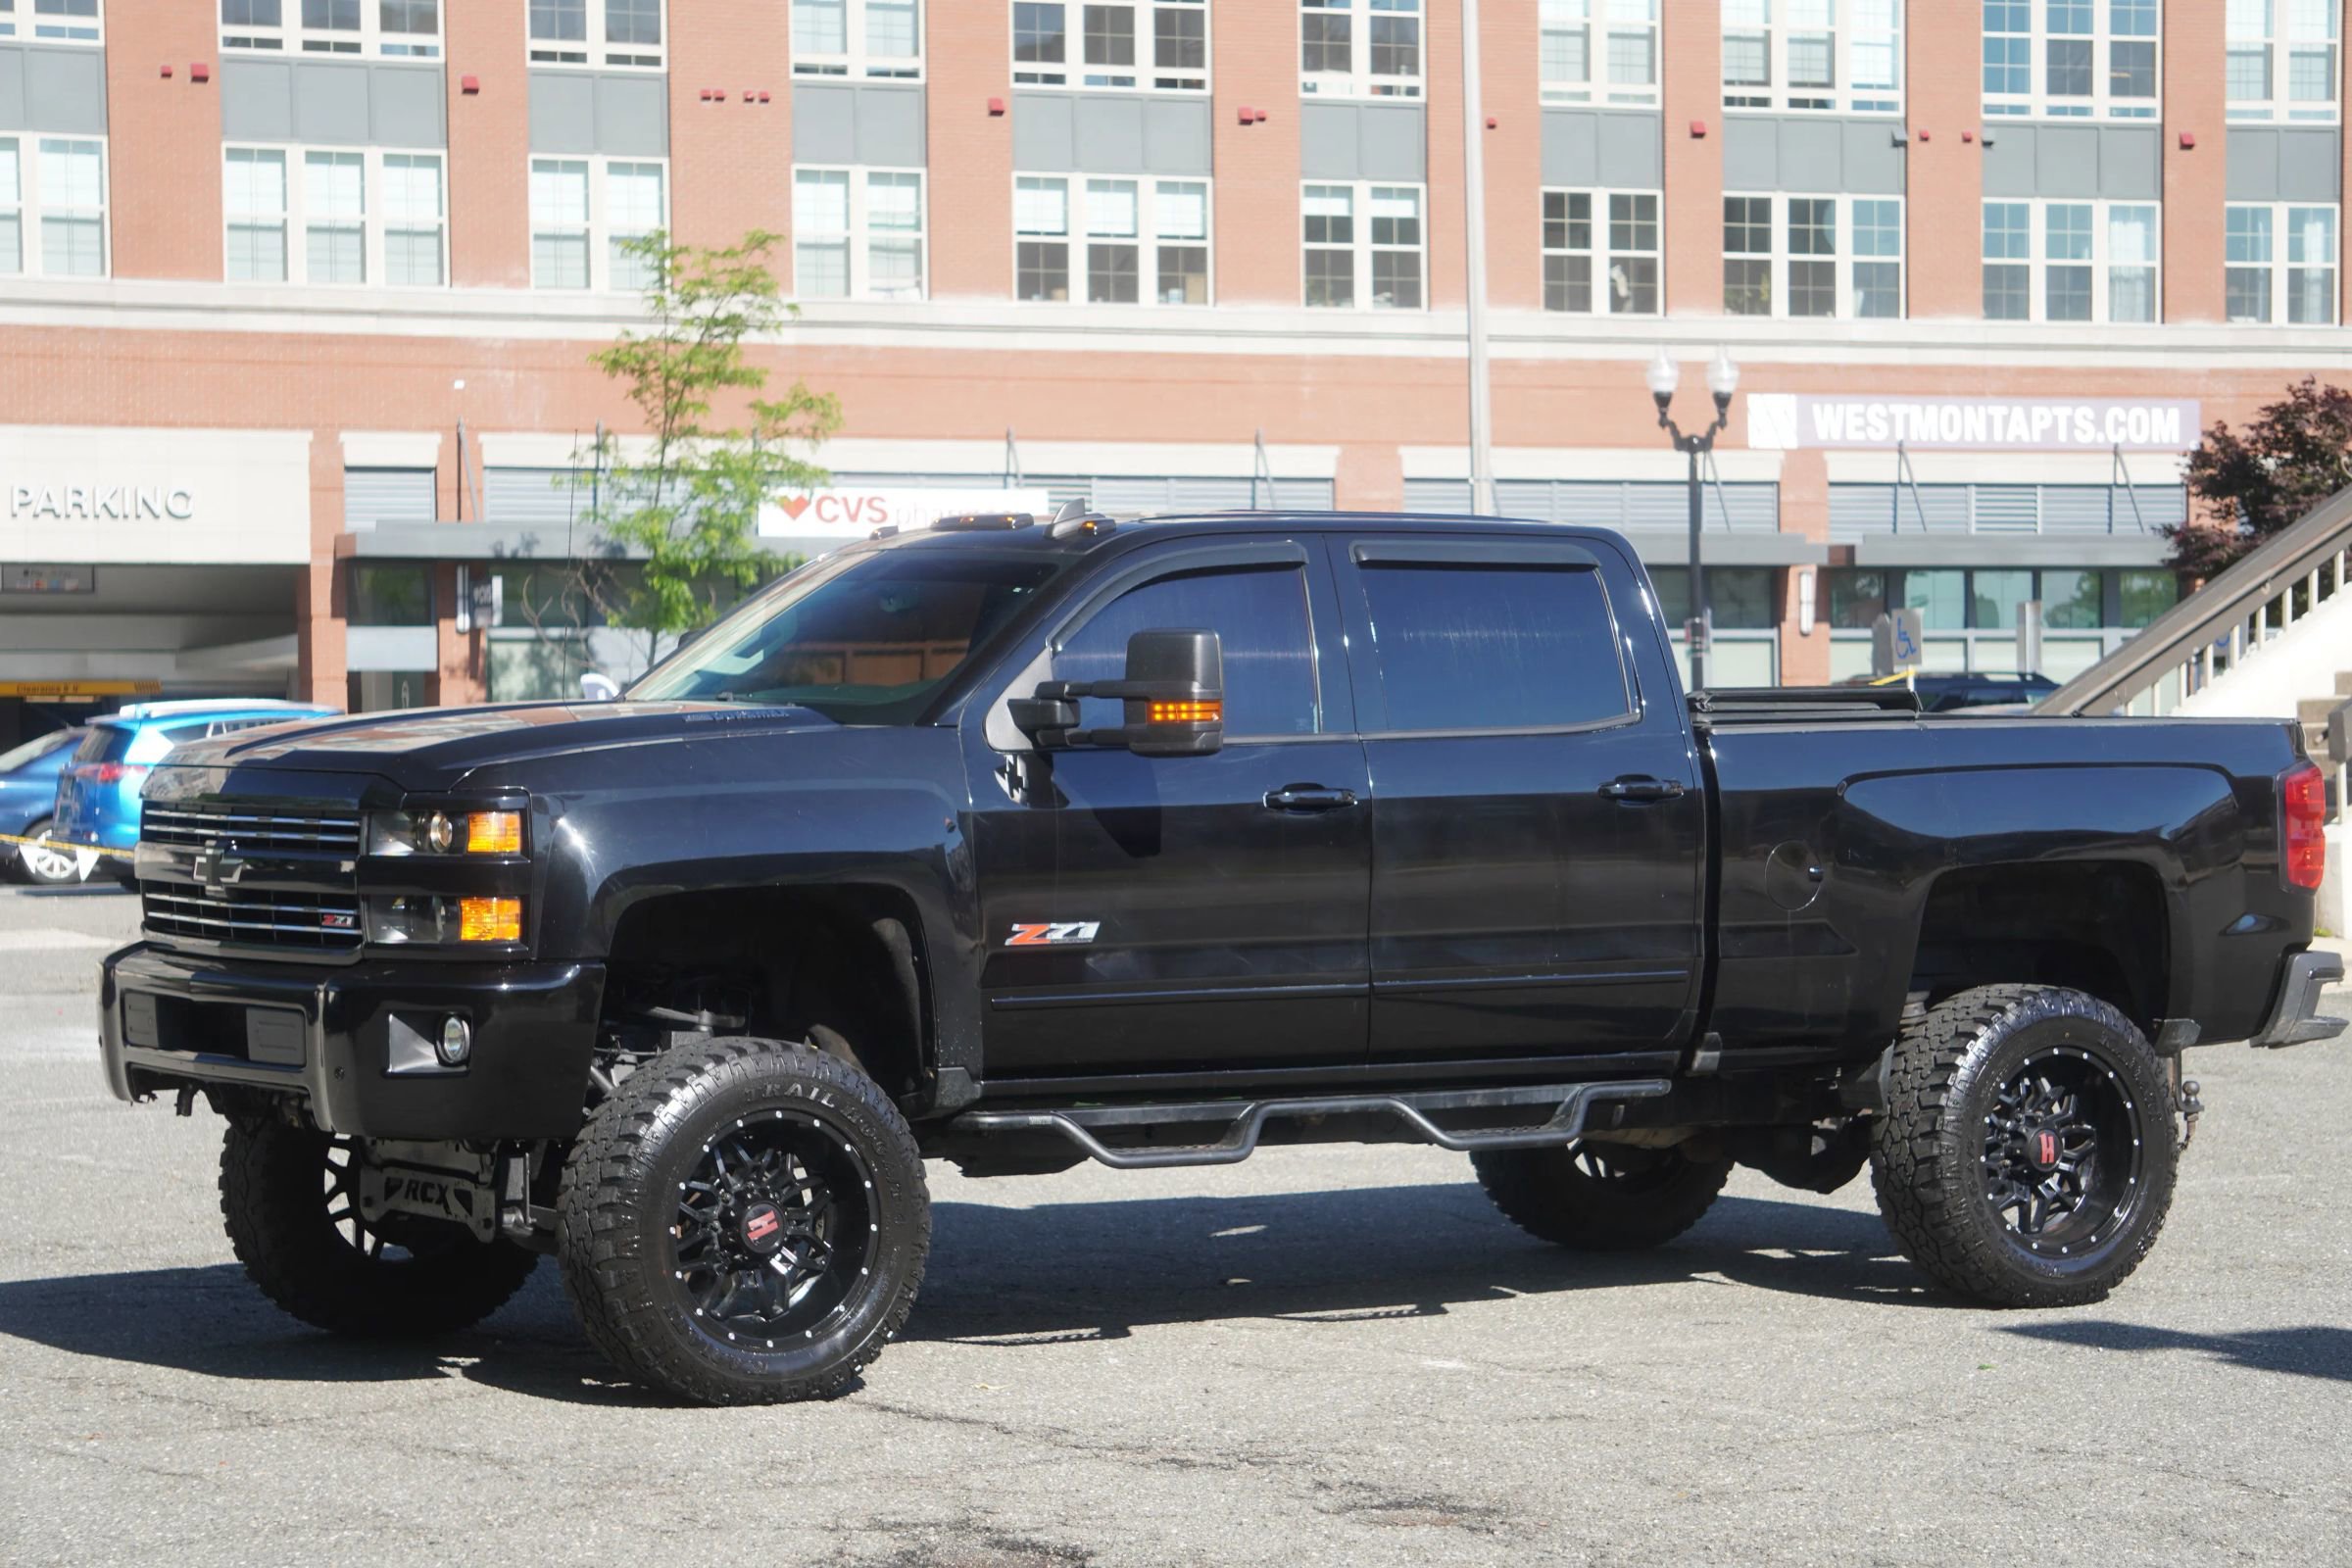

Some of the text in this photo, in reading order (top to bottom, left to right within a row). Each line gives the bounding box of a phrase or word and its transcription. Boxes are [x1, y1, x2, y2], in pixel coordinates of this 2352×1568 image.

[1812, 403, 2180, 445] WESTMONTAPTS.COM
[11, 485, 195, 519] PARKING
[815, 495, 888, 524] CVS
[321, 913, 353, 927] Z71
[1004, 921, 1100, 946] Z71
[745, 1082, 835, 1108] TRAIL
[404, 1178, 452, 1215] RCX
